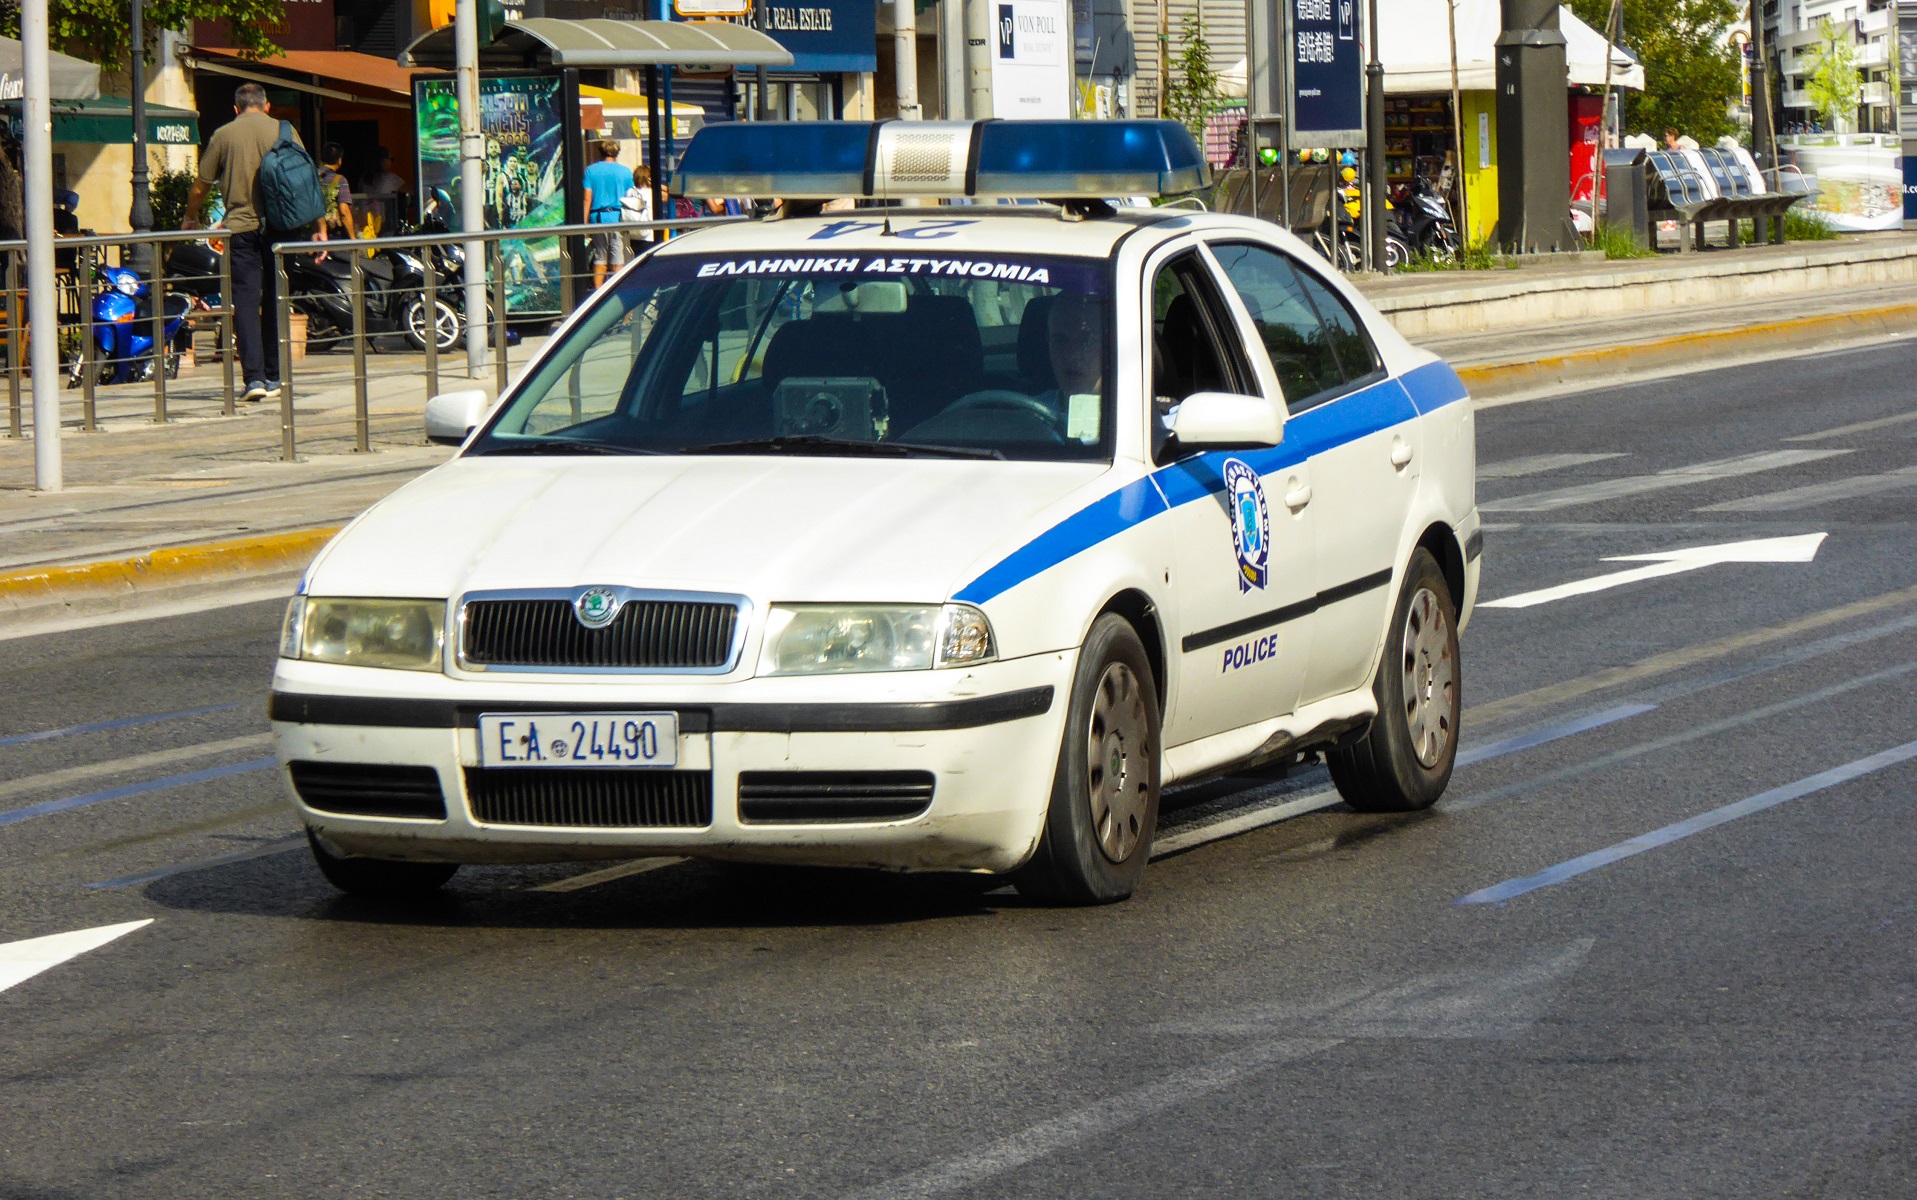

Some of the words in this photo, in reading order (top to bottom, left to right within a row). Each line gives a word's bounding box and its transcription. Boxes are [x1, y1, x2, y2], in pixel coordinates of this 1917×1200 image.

[773, 7, 799, 30] REAL
[799, 8, 833, 31] ESTATE
[1017, 15, 1035, 32] VON
[1036, 16, 1056, 34] POLL
[696, 258, 860, 278] ΕΛΛΗΝΙΚΗ
[864, 258, 1050, 283] ΑΣΤΥΝΟΜΙΑ
[1222, 633, 1278, 674] POLICE
[571, 720, 658, 761] 24490
